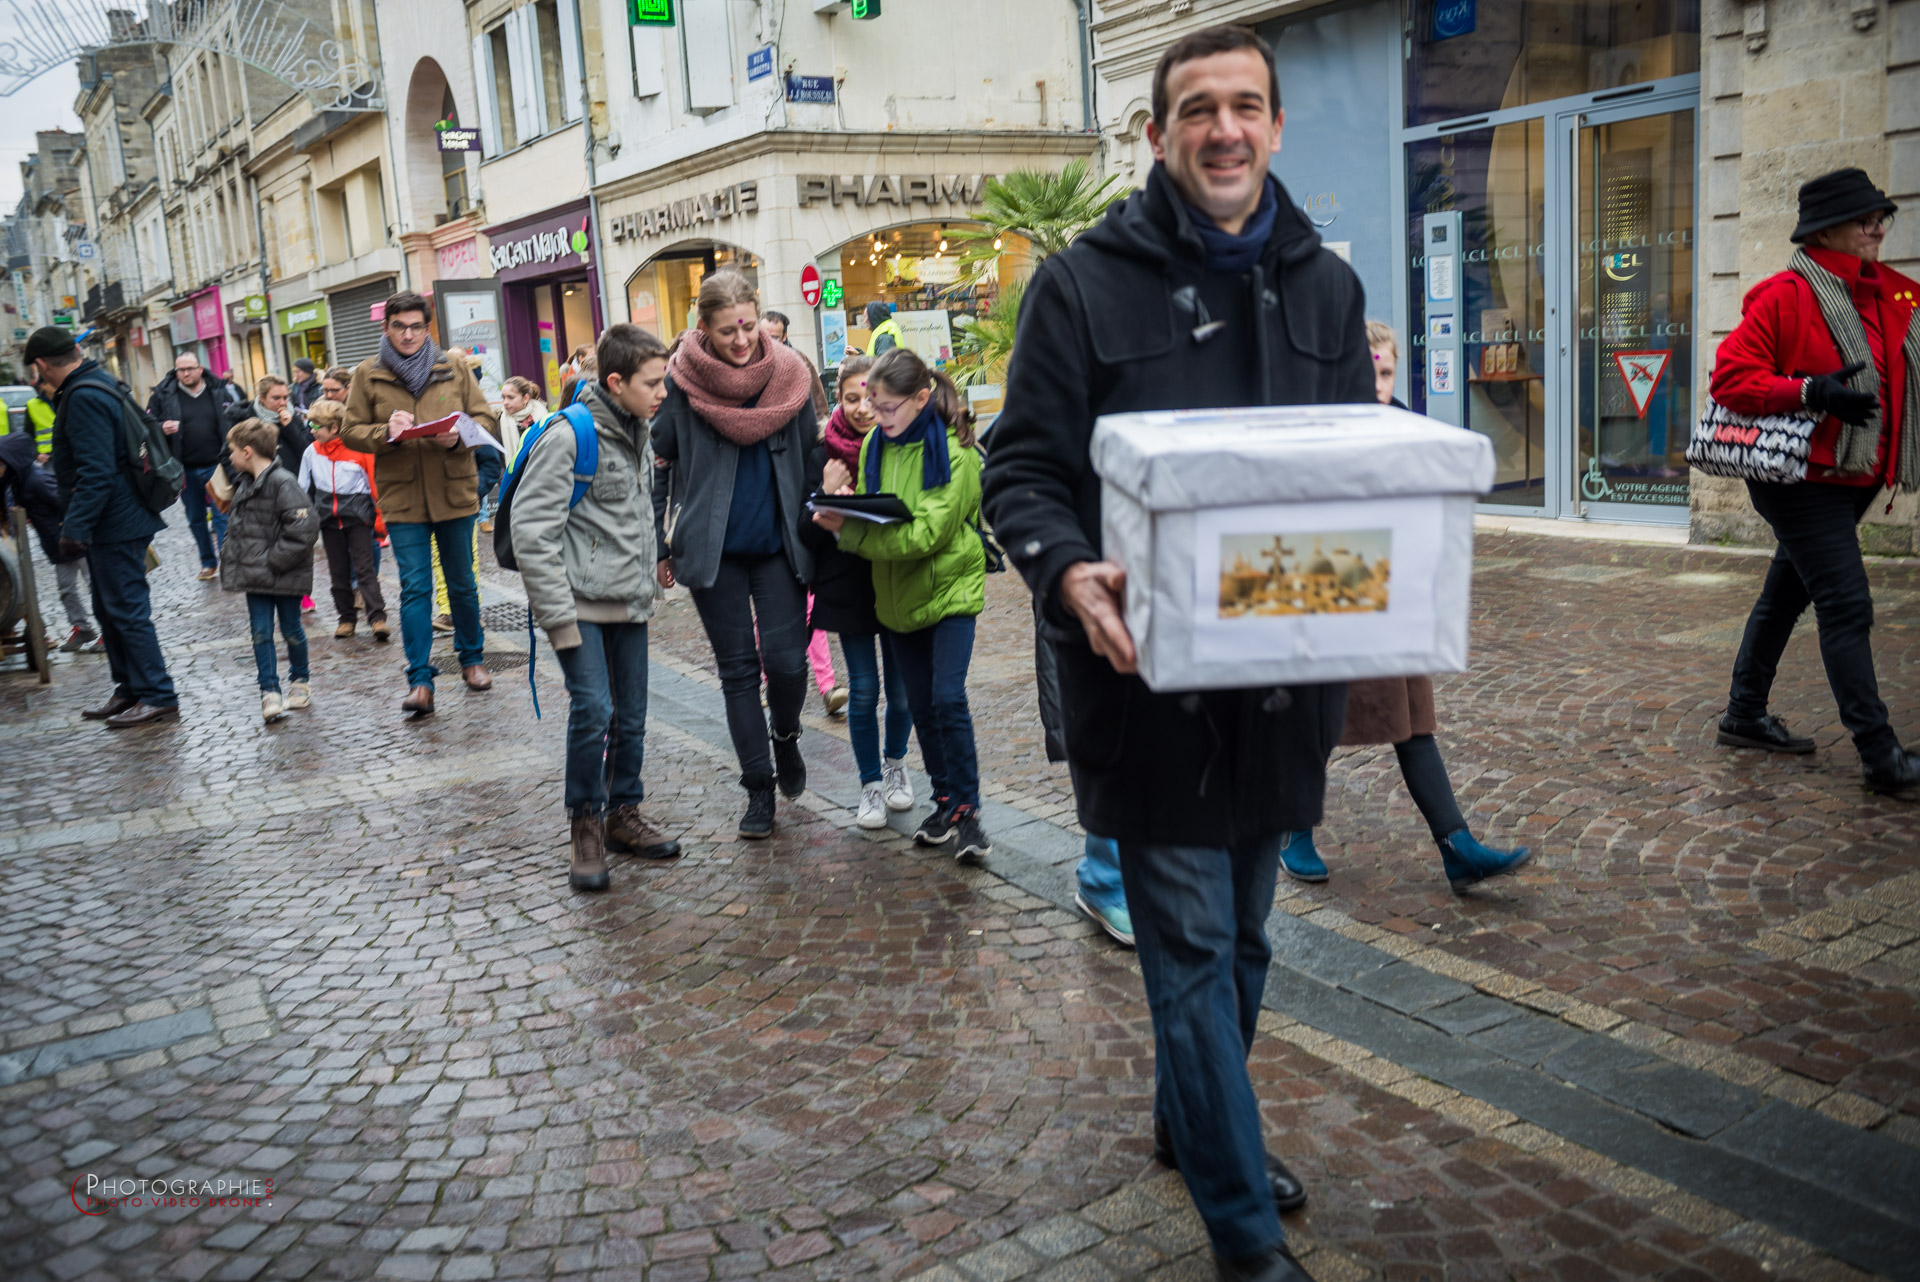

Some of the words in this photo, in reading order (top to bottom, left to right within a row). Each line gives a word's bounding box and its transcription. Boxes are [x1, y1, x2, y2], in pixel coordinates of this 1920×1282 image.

[802, 79, 819, 89] RUE
[610, 180, 758, 242] PHARMACIE
[1619, 235, 1652, 249] LCL
[1658, 230, 1693, 245] LCL
[1412, 256, 1425, 268] LC
[1462, 249, 1489, 263] LCL
[1494, 246, 1523, 260] LCL
[1528, 243, 1545, 257] LC
[1413, 334, 1425, 346] LC
[1463, 331, 1489, 344] LCL
[1494, 330, 1523, 342] LCL
[1528, 329, 1545, 341] LC
[1657, 322, 1692, 337] LCL
[1614, 482, 1648, 492] VOTRE
[1610, 492, 1629, 501] EST
